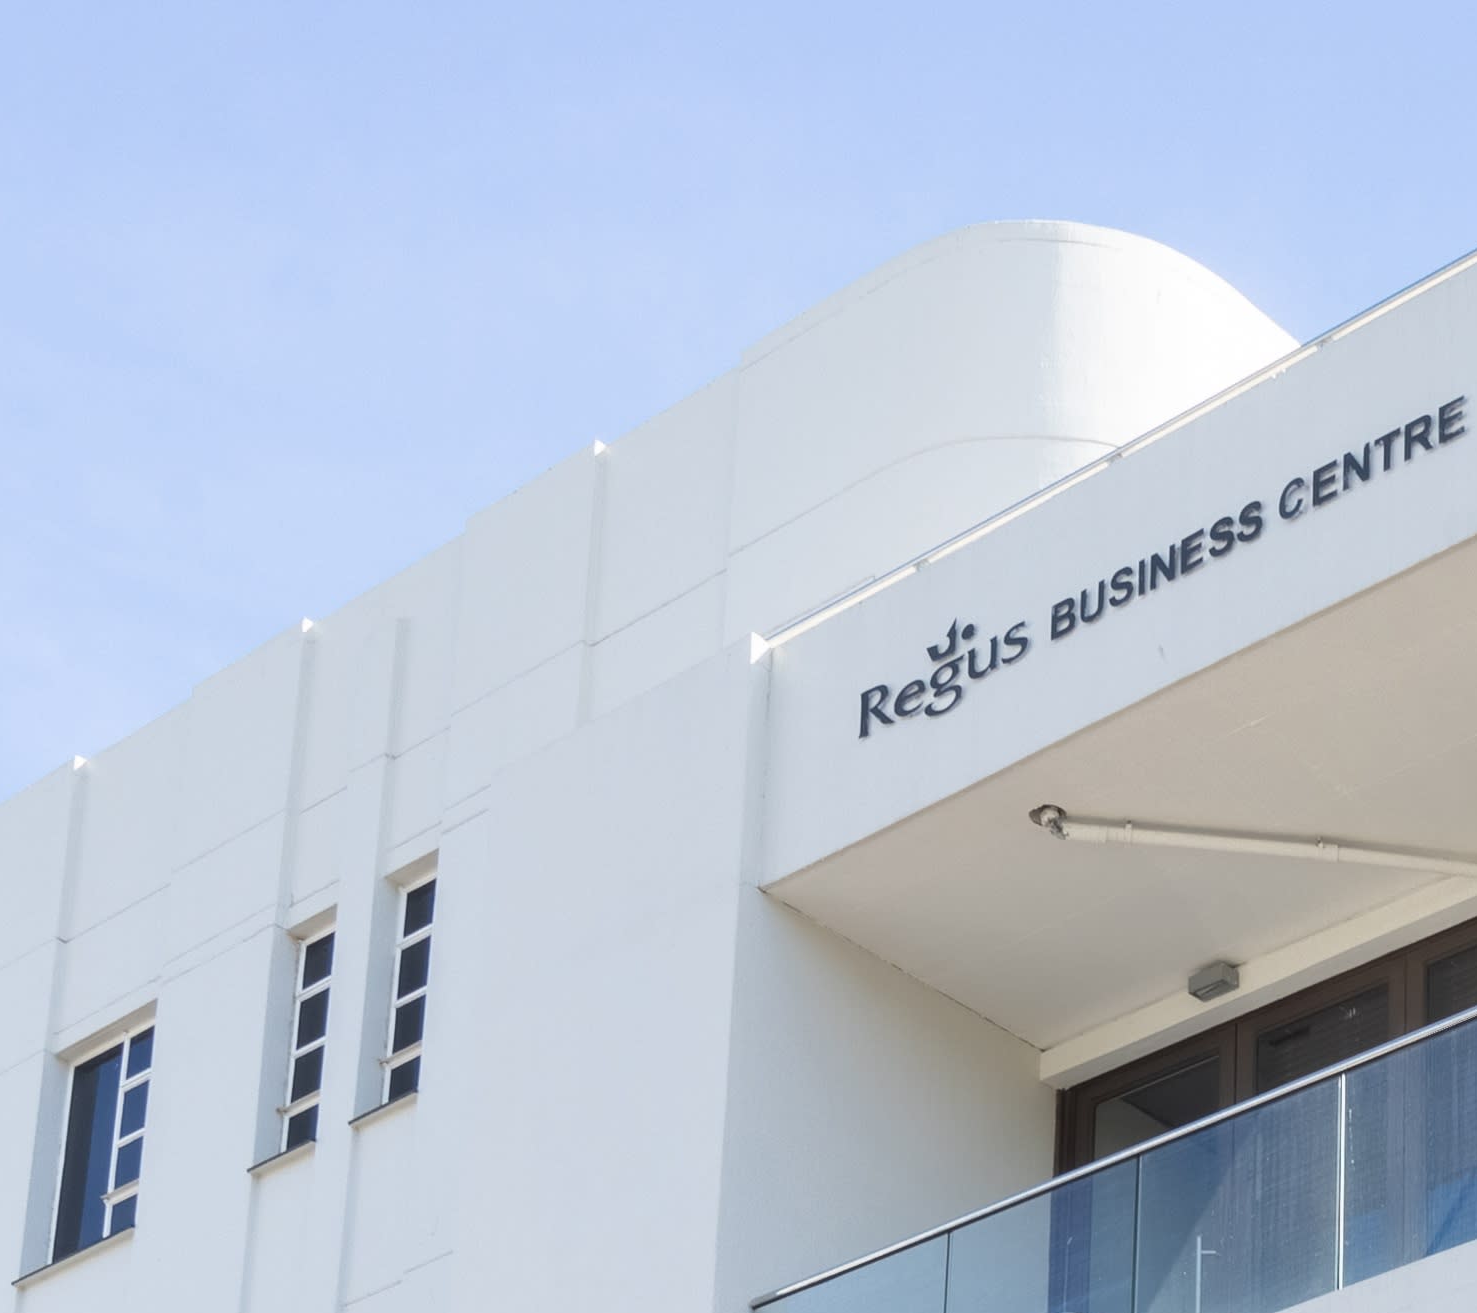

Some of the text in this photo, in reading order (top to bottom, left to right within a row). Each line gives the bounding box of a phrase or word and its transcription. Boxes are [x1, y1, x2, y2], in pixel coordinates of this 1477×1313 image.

[858, 396, 1469, 738] Regus BUSINESS CENTRE
